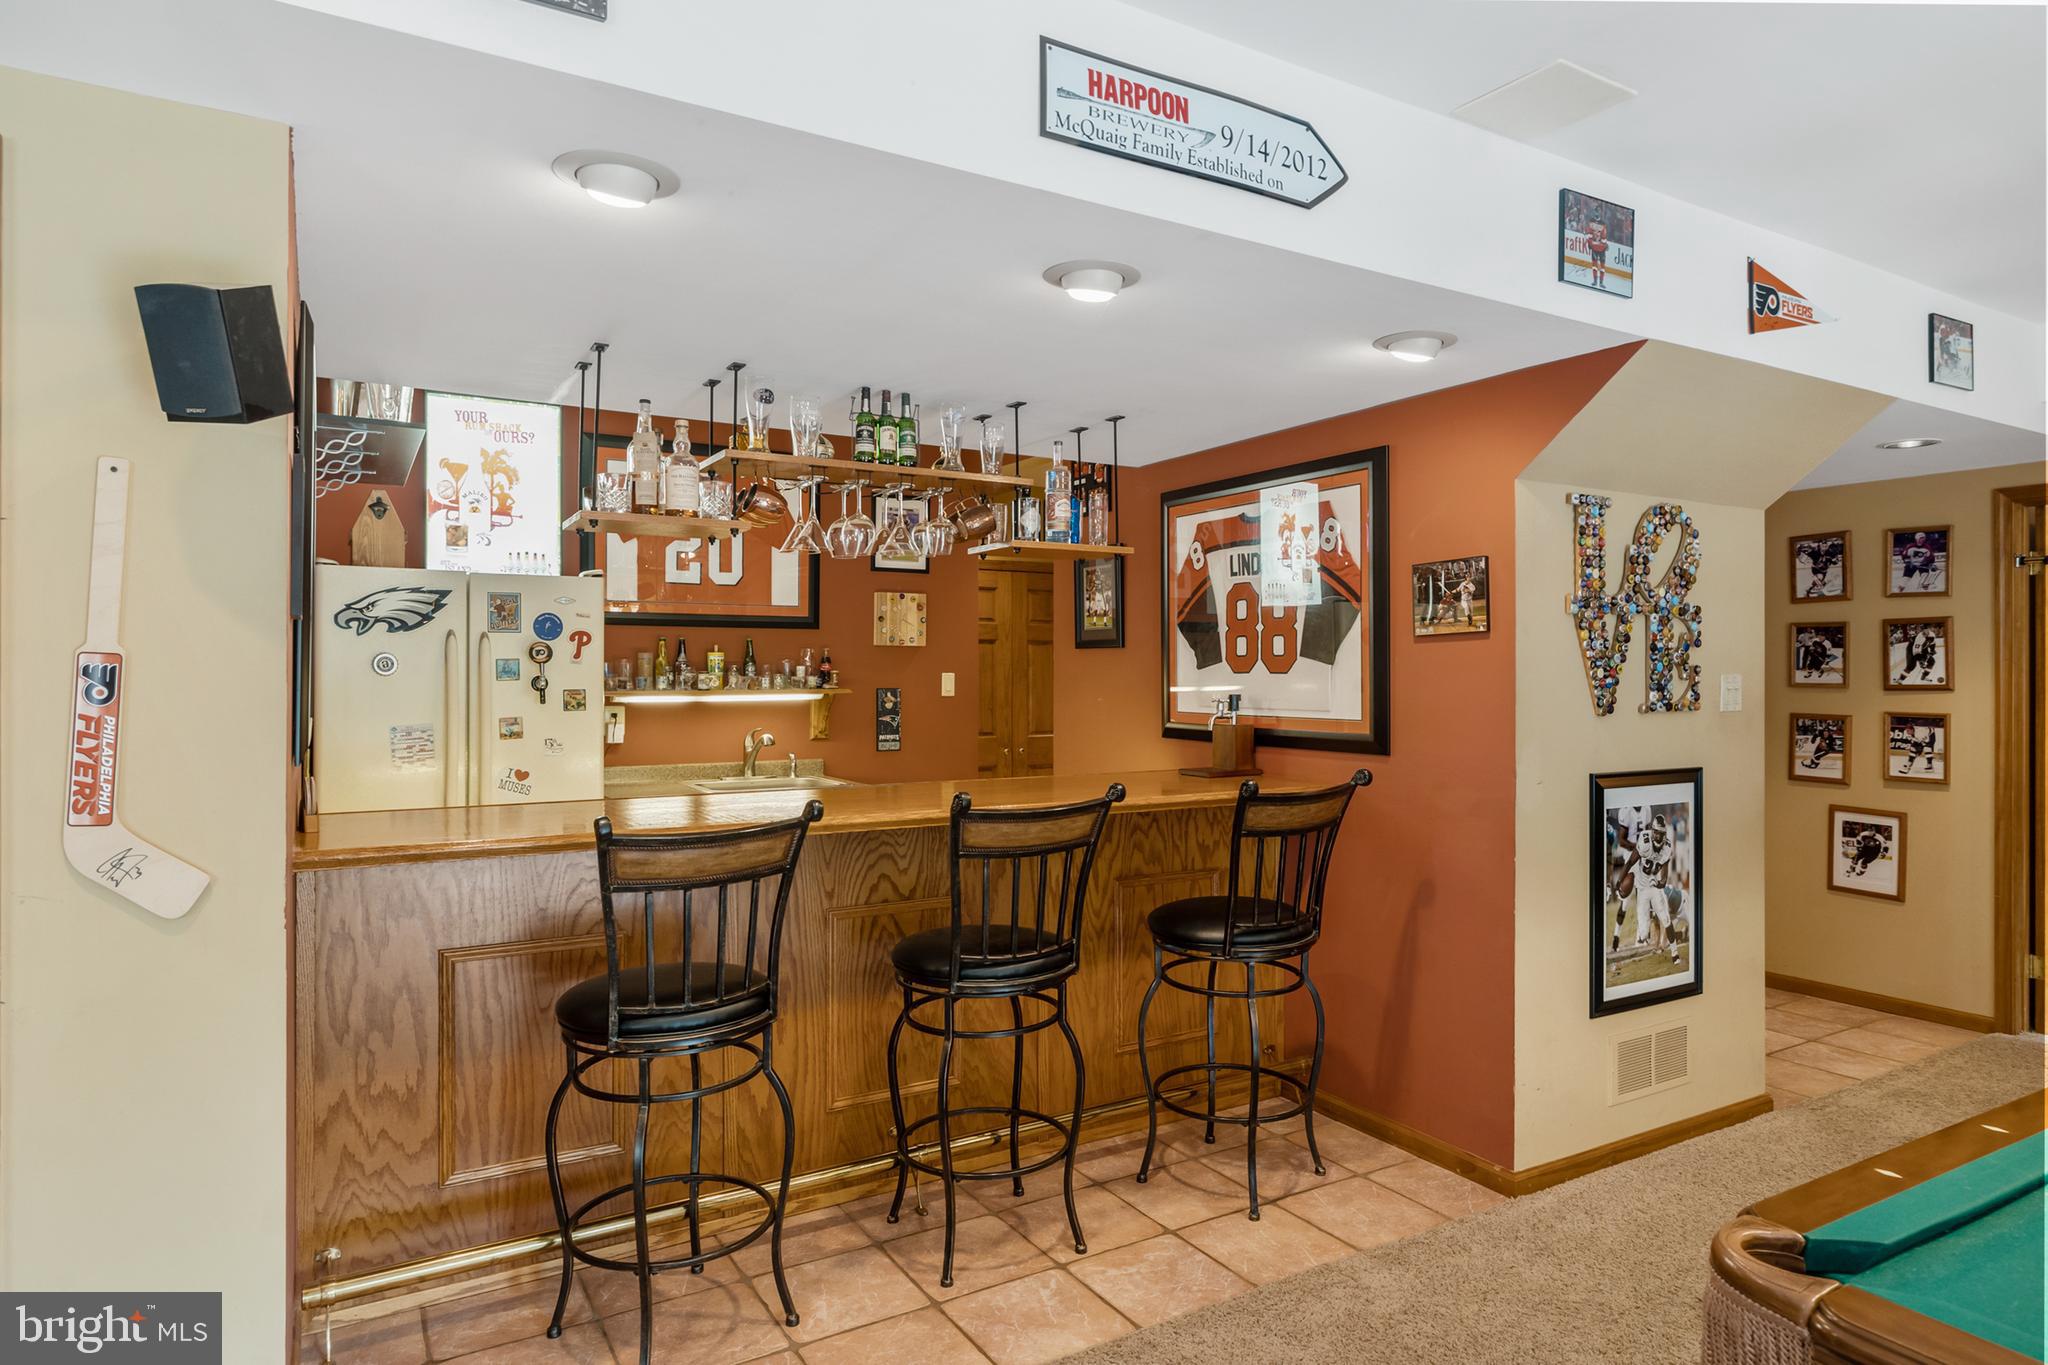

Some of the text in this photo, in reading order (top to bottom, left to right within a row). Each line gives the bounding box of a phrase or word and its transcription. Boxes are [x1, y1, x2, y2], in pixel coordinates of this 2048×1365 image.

[1087, 67, 1189, 124] HARPOON
[1088, 105, 1190, 143] BREWERY
[1054, 110, 1285, 192] McQuaig Family Established on
[1220, 124, 1329, 181] 9/14/2012
[1781, 299, 1814, 319] FLYERS
[454, 410, 488, 423] YOUR
[494, 430, 535, 444] OURS?
[1321, 517, 1341, 554] 8
[1229, 552, 1261, 577] LIND
[1225, 581, 1298, 674] 88
[71, 713, 101, 817] FLYERS
[97, 715, 116, 815] PHILADELPHIA
[498, 778, 532, 796] MUSES
